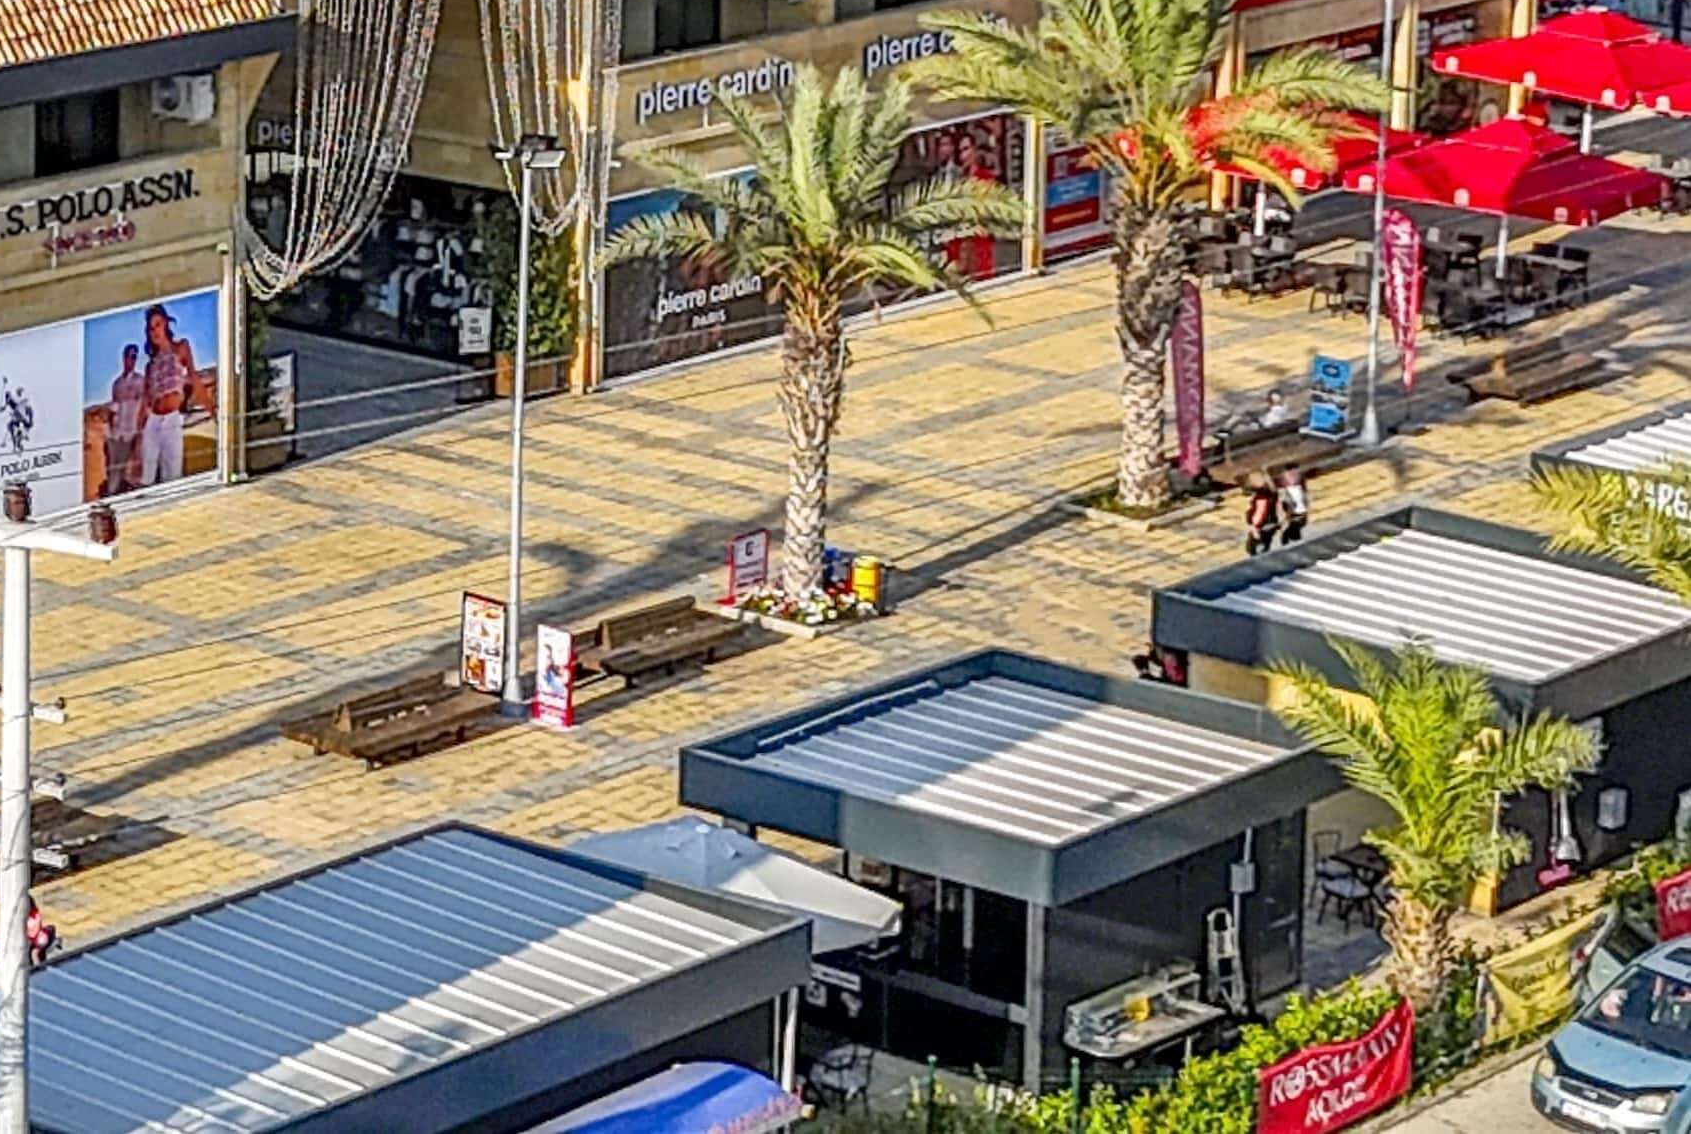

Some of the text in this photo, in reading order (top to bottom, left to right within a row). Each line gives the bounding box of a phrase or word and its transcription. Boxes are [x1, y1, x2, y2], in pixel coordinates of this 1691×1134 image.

[866, 31, 936, 79] pierre
[638, 56, 795, 126] pierre cardin
[37, 186, 113, 231] POLO
[118, 168, 201, 212] ASSN.
[1269, 1022, 1402, 1107] ROSSMANN
